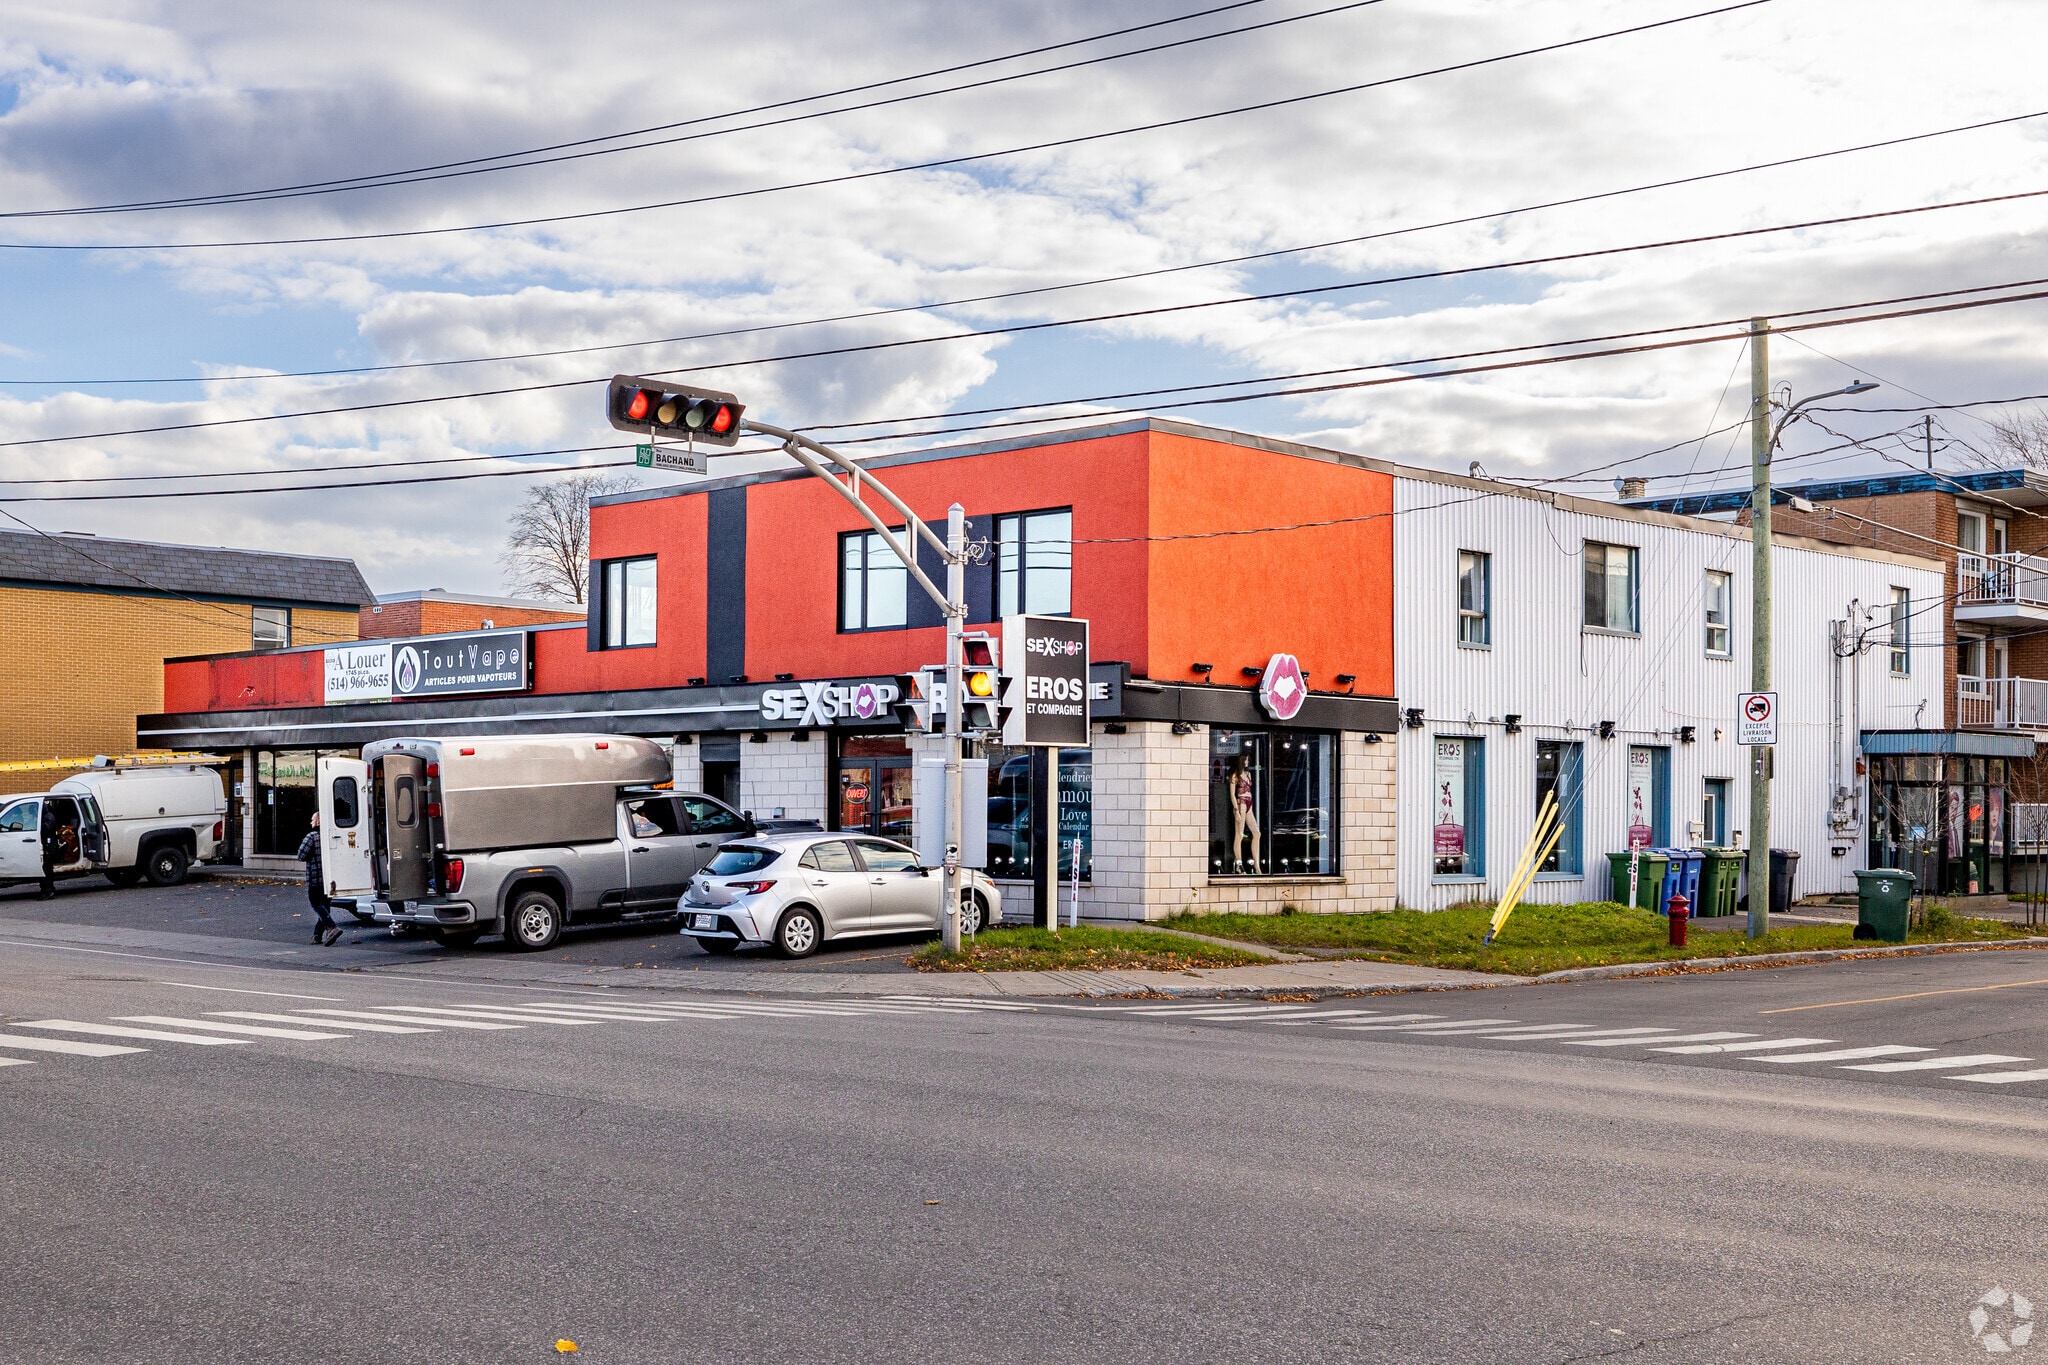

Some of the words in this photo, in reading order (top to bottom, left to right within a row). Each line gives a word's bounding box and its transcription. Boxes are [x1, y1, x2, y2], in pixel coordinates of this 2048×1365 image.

[656, 454, 694, 466] BACHAND
[1026, 636, 1083, 656] SEXSHOP
[347, 651, 386, 669] Louer
[328, 676, 348, 692] (514)
[350, 673, 389, 689] 966-9655
[424, 676, 456, 687] ARTICLES
[457, 675, 476, 684] POUR
[477, 671, 517, 683] VAPOTEURS
[1026, 675, 1083, 701] EROS
[762, 682, 899, 725] SEXSHOP
[1026, 703, 1036, 714] ET
[1037, 703, 1083, 716] COMPAGNIE
[1438, 743, 1461, 756] EROS
[1631, 752, 1649, 764] EROS
[1061, 807, 1088, 821] Love
[1058, 822, 1089, 831] Calendar
[1063, 840, 1084, 850] ERS
